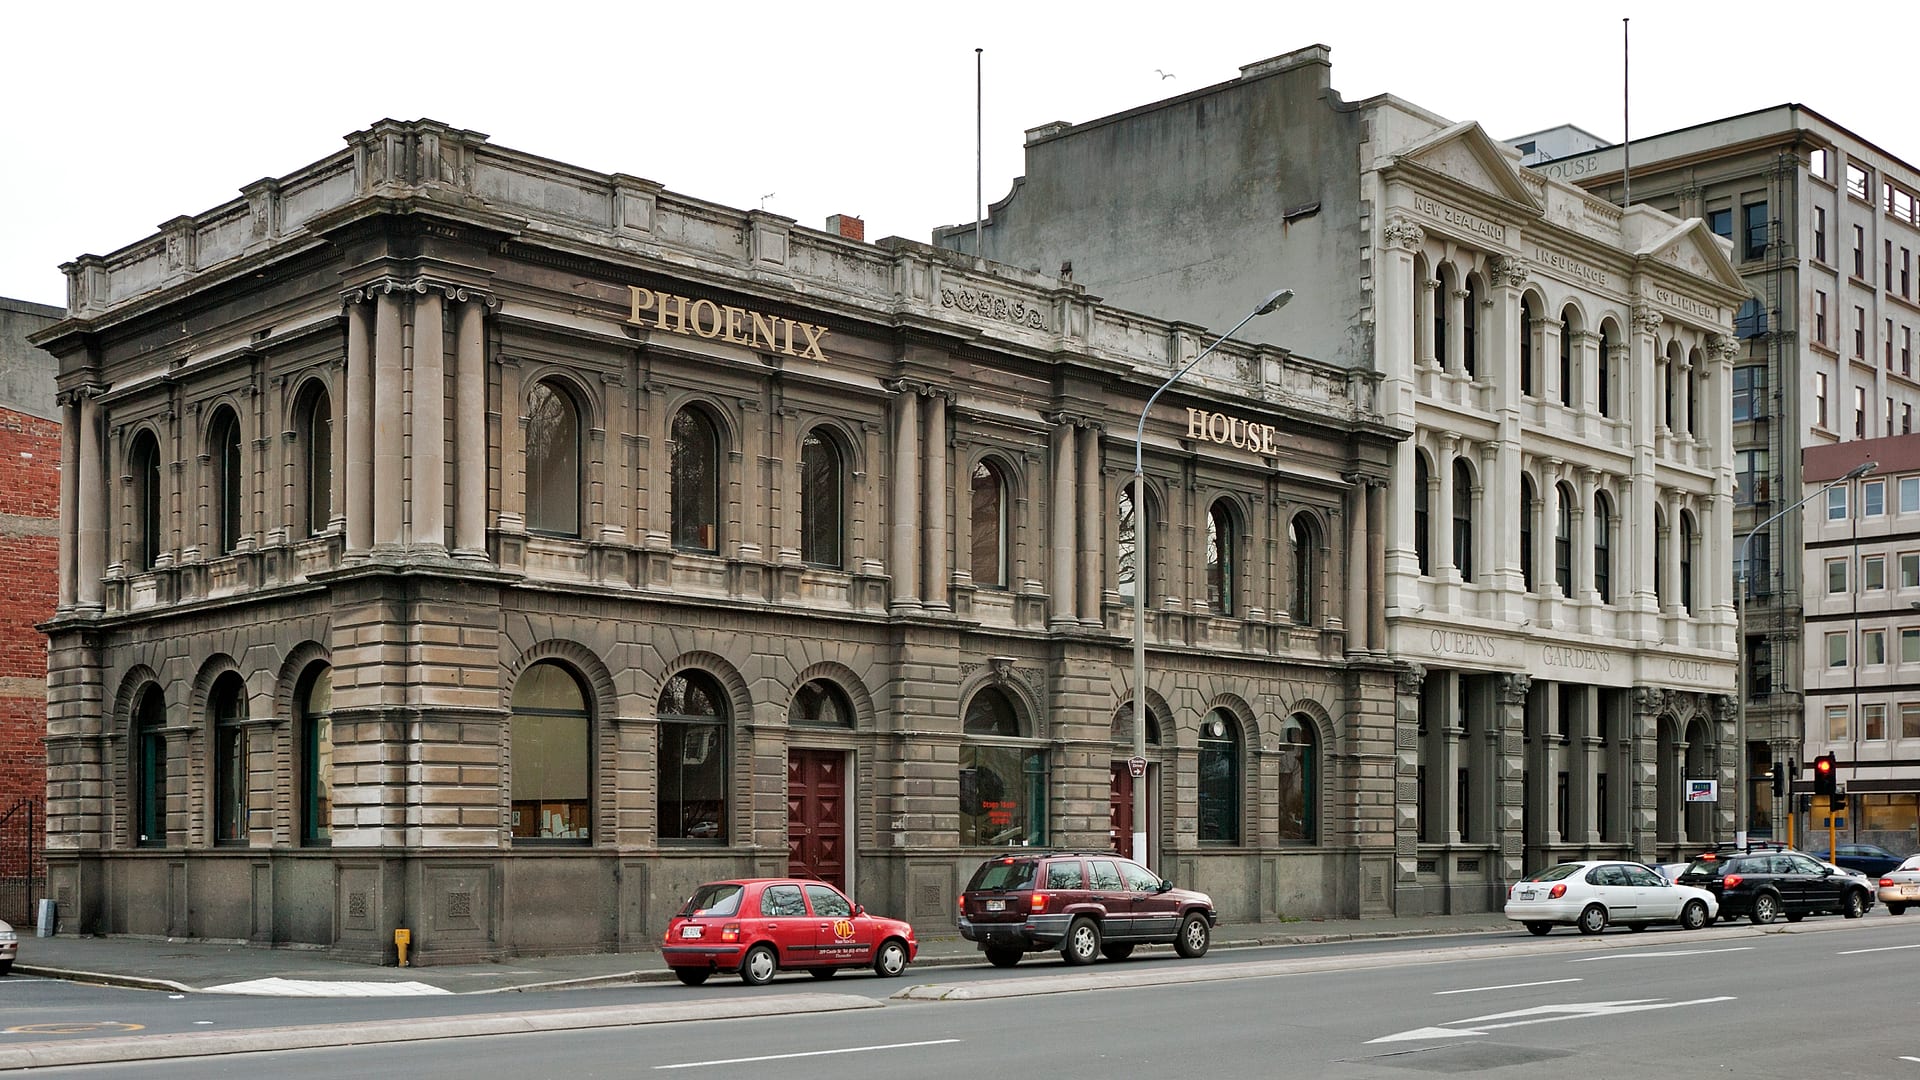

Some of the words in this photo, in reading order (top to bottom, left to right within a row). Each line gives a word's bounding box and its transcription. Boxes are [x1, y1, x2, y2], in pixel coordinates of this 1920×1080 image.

[1414, 196, 1441, 217] NEW
[1445, 208, 1504, 240] ZEALAND
[627, 285, 830, 362] PHOENIX
[1186, 407, 1277, 455] HOUSE
[1430, 629, 1496, 657] QUEENS
[1543, 644, 1611, 672] GARDENS
[1669, 658, 1711, 681] COURT
